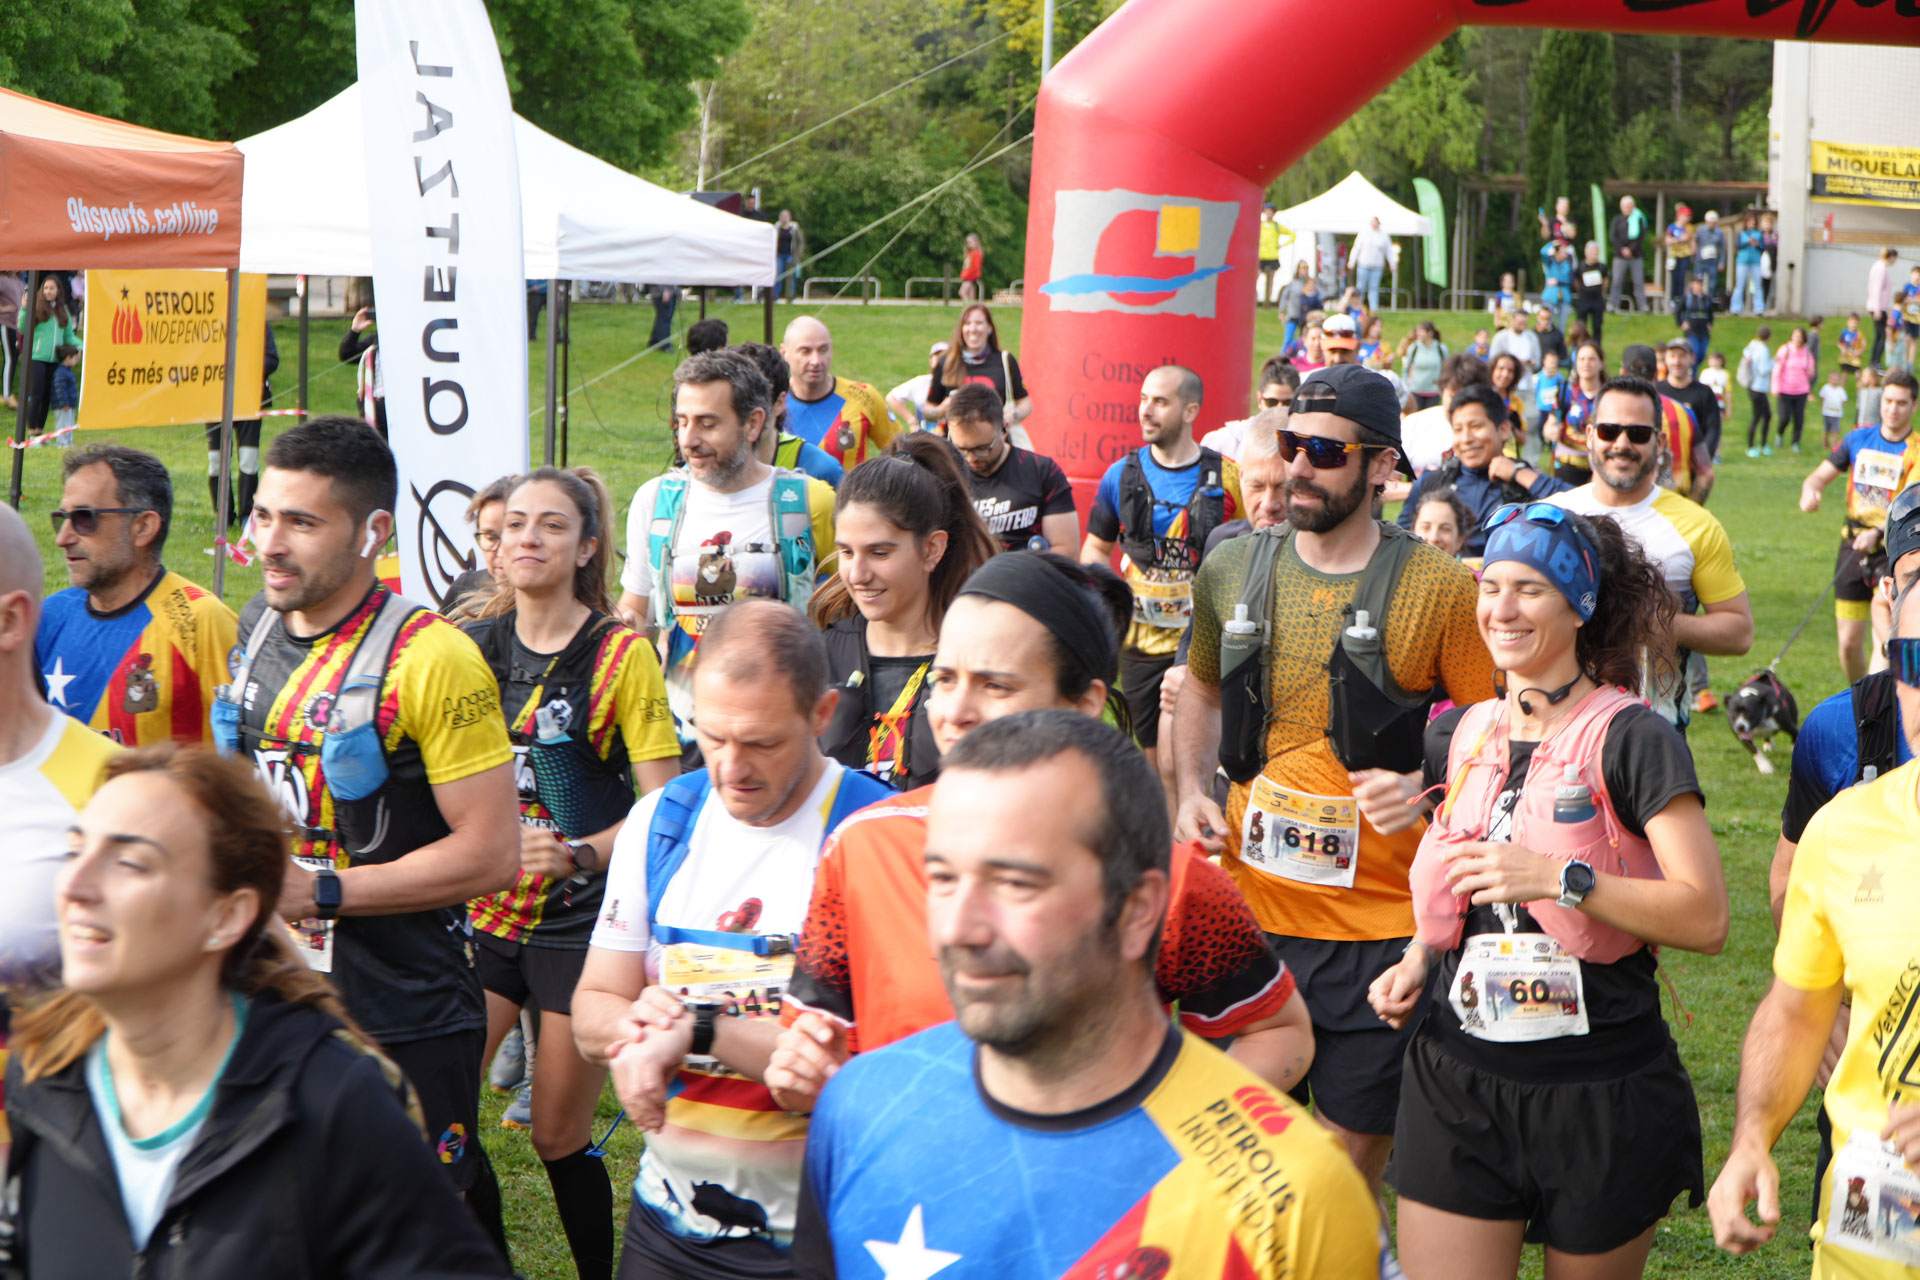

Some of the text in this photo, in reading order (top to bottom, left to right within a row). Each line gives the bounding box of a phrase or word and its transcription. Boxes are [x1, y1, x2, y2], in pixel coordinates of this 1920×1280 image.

[67, 197, 218, 241] 9hsports.cat/live
[145, 291, 215, 315] PETROLIS
[107, 360, 227, 388] és més que pre
[1068, 391, 1138, 424] Coma
[1284, 826, 1340, 856] 618
[1509, 979, 1550, 1004] 60
[1205, 1098, 1296, 1214] PETROLIS
